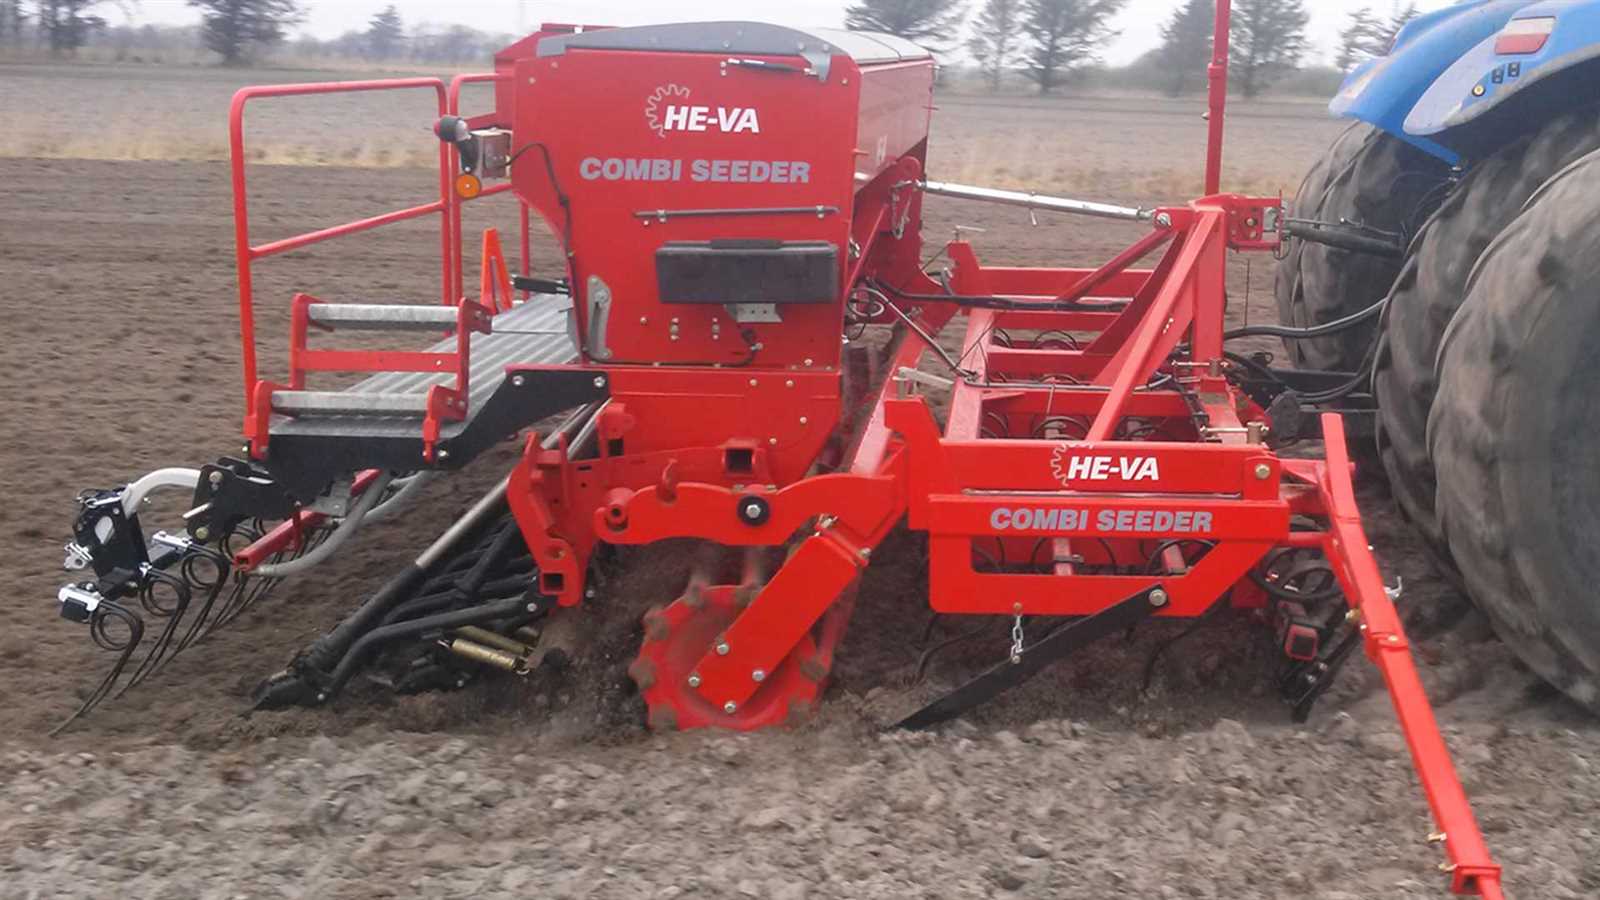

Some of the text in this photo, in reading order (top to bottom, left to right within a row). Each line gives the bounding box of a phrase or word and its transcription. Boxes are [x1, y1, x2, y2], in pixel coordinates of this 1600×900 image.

[663, 105, 760, 133] HE-VA
[579, 157, 811, 184] COMBI SEEDER
[1067, 456, 1159, 481] HE-VA
[990, 507, 1213, 533] COMBI SEEDER
